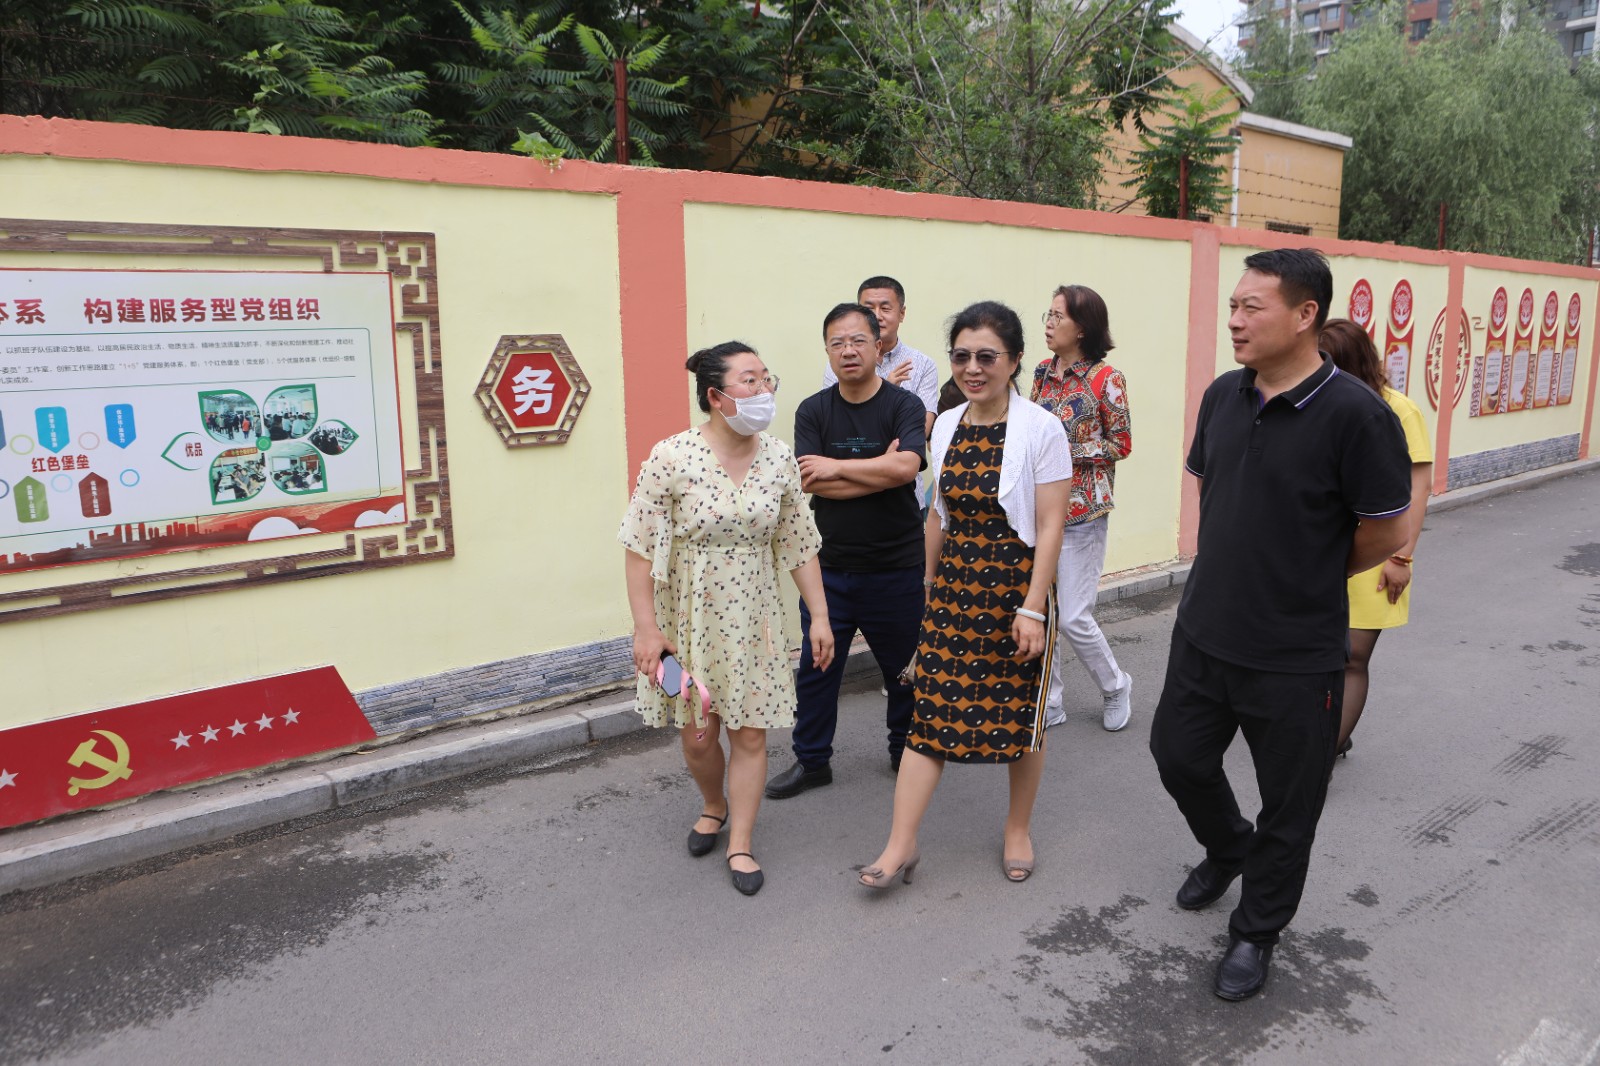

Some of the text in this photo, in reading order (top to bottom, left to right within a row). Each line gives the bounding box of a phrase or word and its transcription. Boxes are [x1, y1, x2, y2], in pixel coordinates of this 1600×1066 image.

[83, 297, 322, 325] 构建服务型党组织
[511, 366, 555, 416] 务
[184, 442, 204, 458] 优品
[31, 453, 91, 473] 红色堡垒
